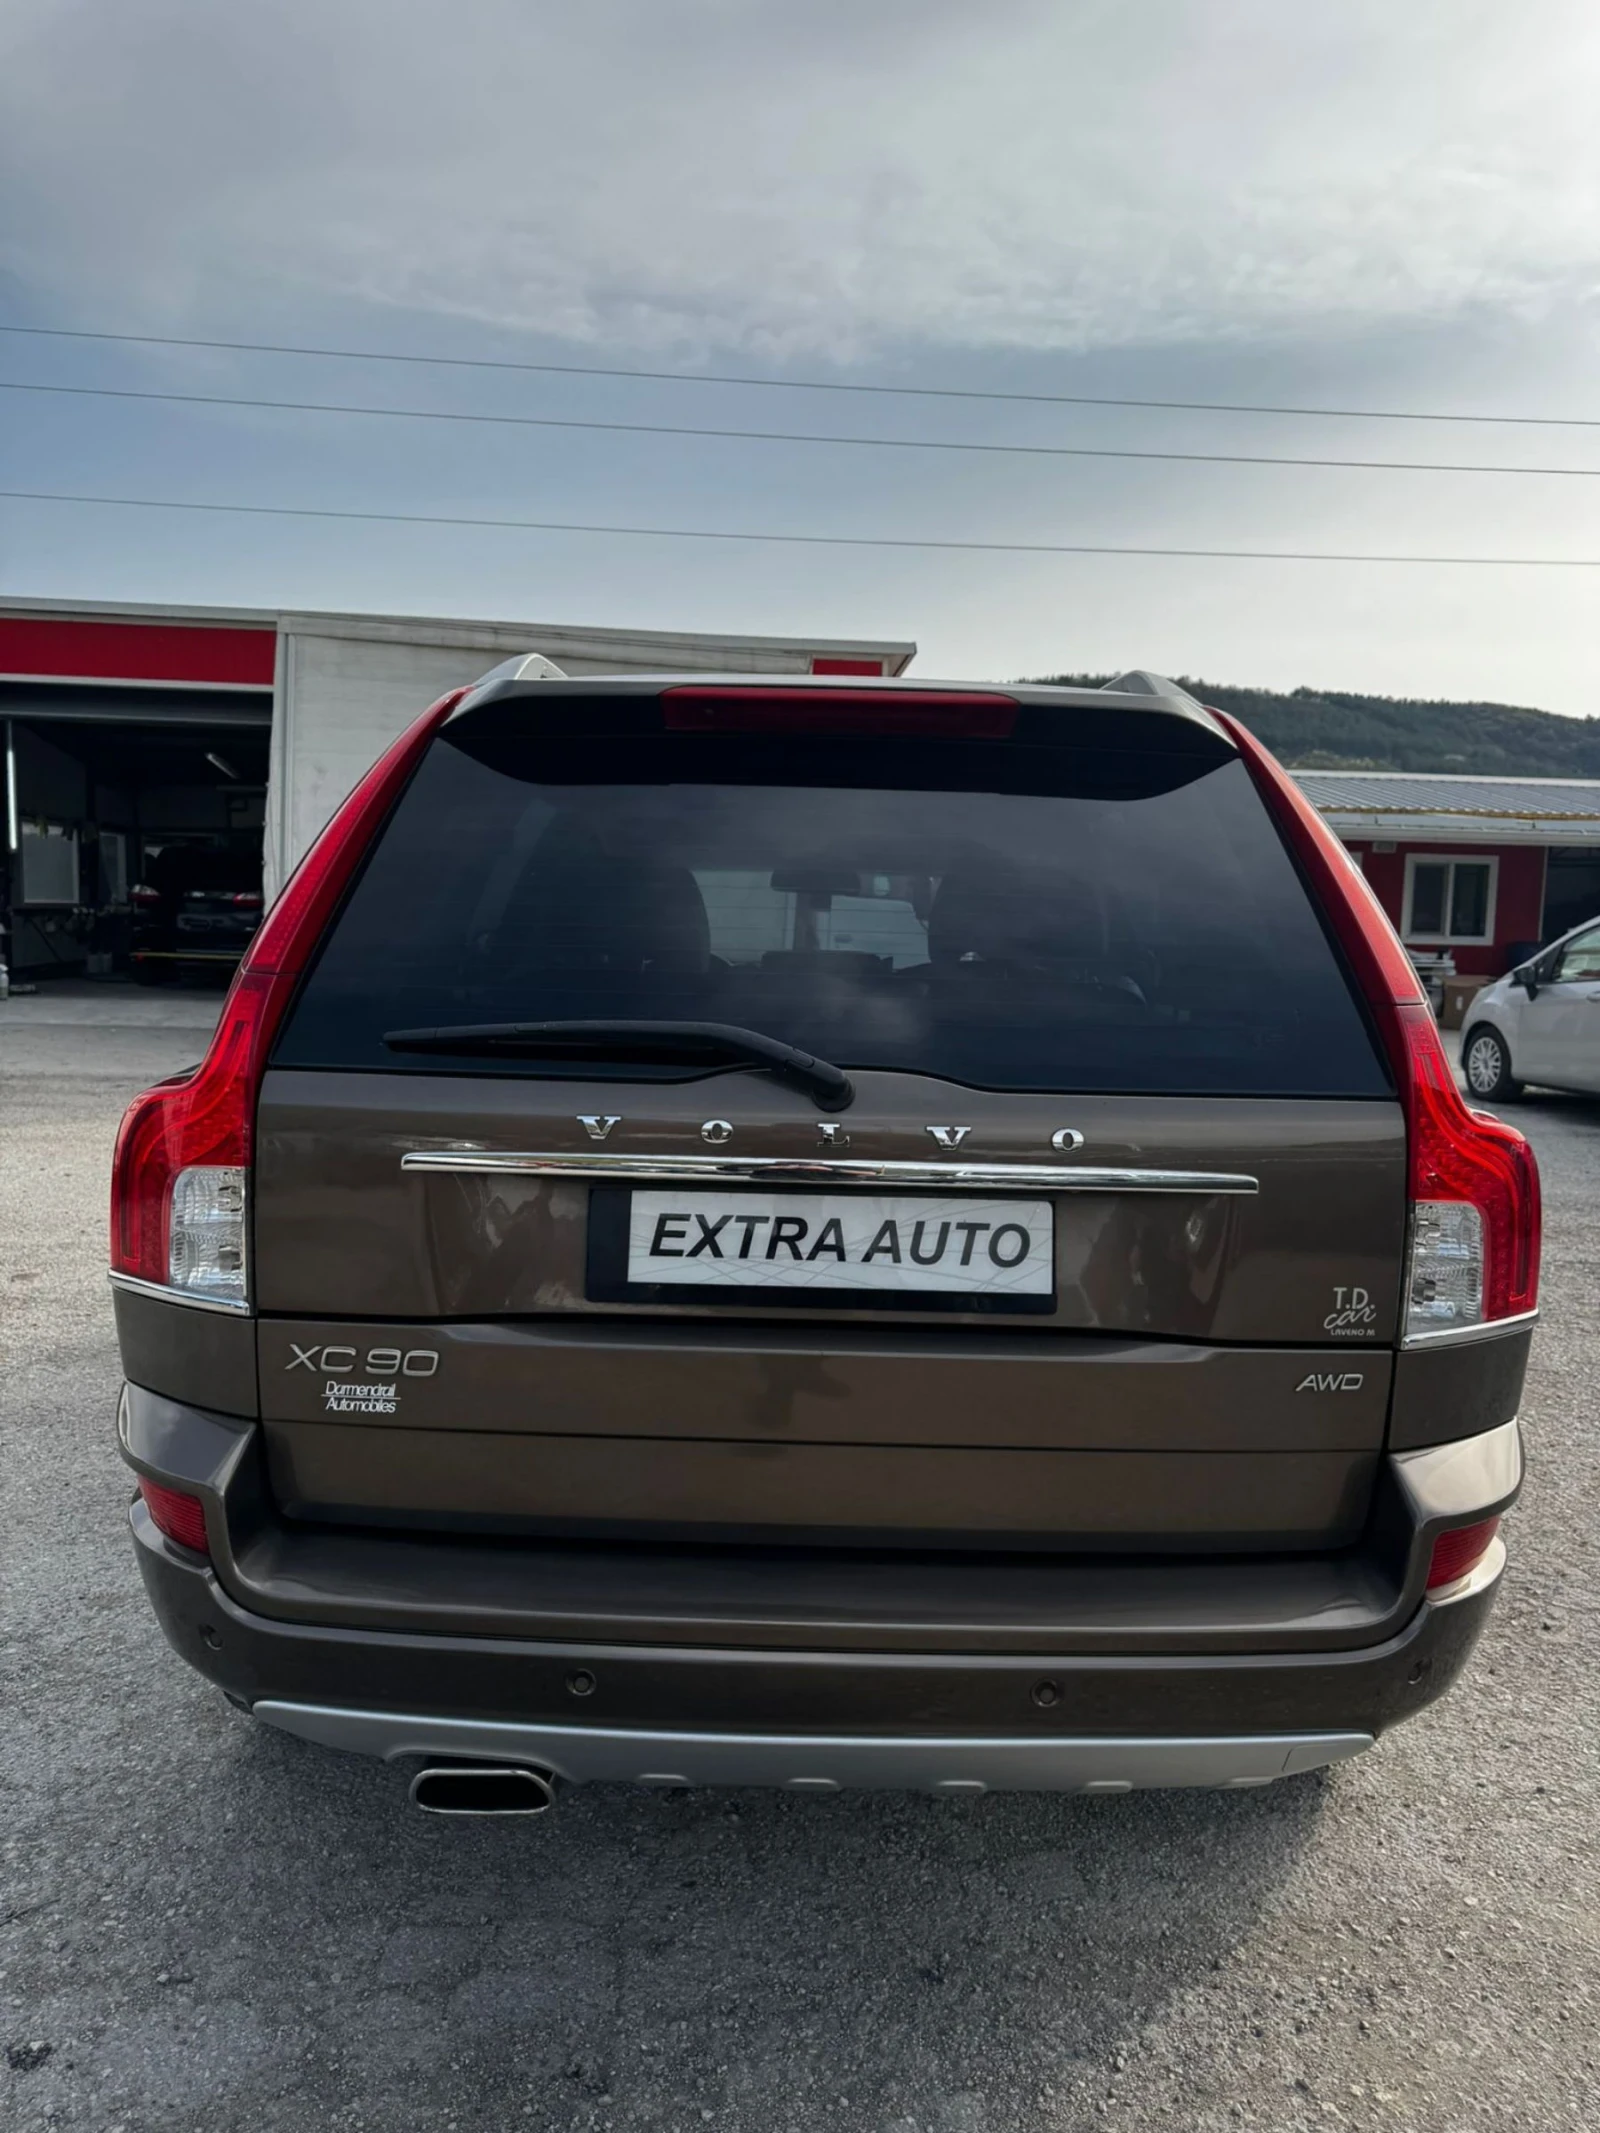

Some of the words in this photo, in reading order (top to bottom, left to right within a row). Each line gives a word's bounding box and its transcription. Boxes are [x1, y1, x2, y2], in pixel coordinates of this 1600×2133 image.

[576, 1115, 1085, 1152] VOLVO
[649, 1213, 847, 1262] EXTRA
[860, 1218, 1031, 1269] AUTO
[1332, 1286, 1376, 1310] T.D.
[1295, 1373, 1364, 1392] AWD
[324, 1397, 397, 1413] Automobiles
